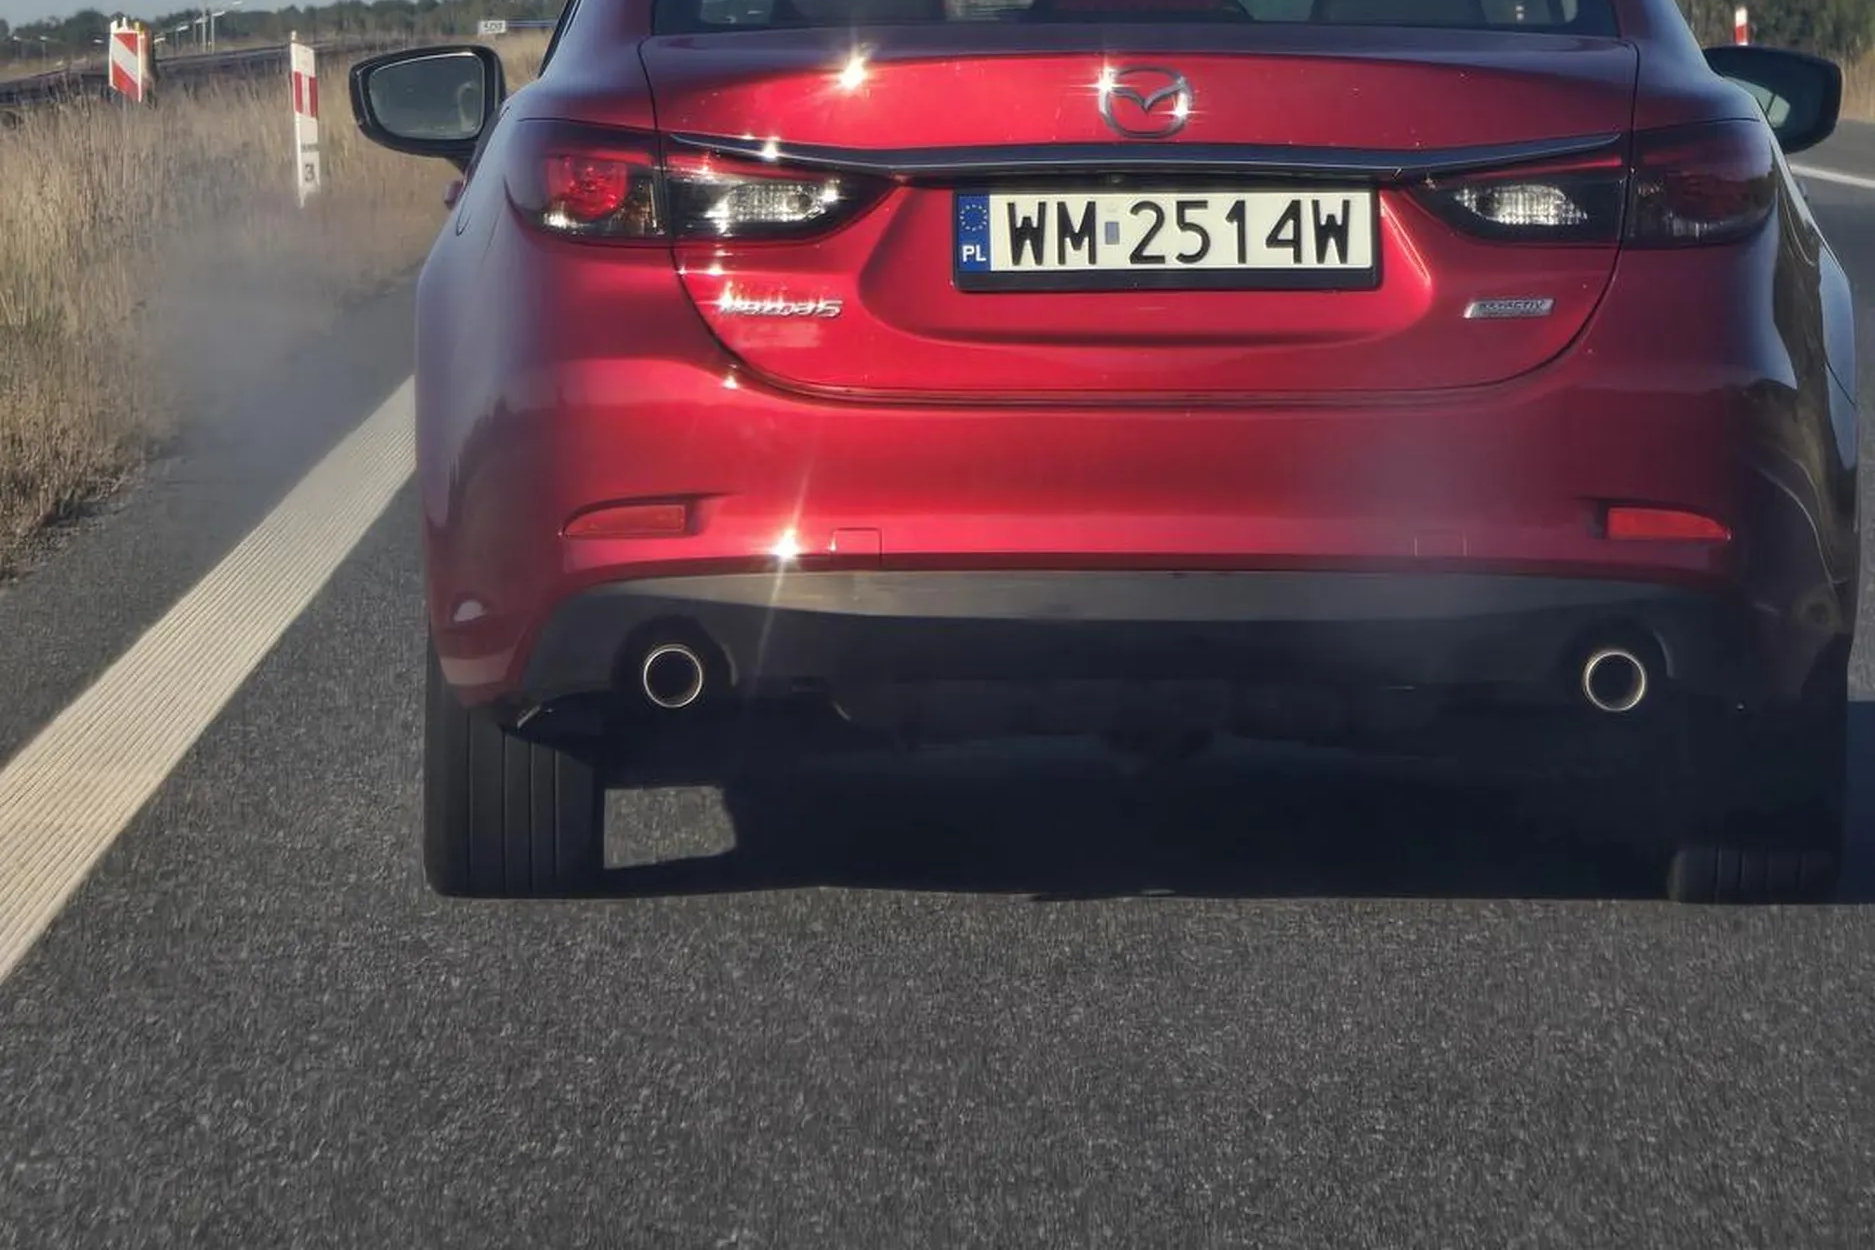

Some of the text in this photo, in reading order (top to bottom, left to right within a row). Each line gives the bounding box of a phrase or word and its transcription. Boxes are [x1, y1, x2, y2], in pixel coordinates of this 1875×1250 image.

[304, 162, 315, 182] 3
[1006, 199, 1352, 266] WM 2514W
[961, 245, 987, 263] PL
